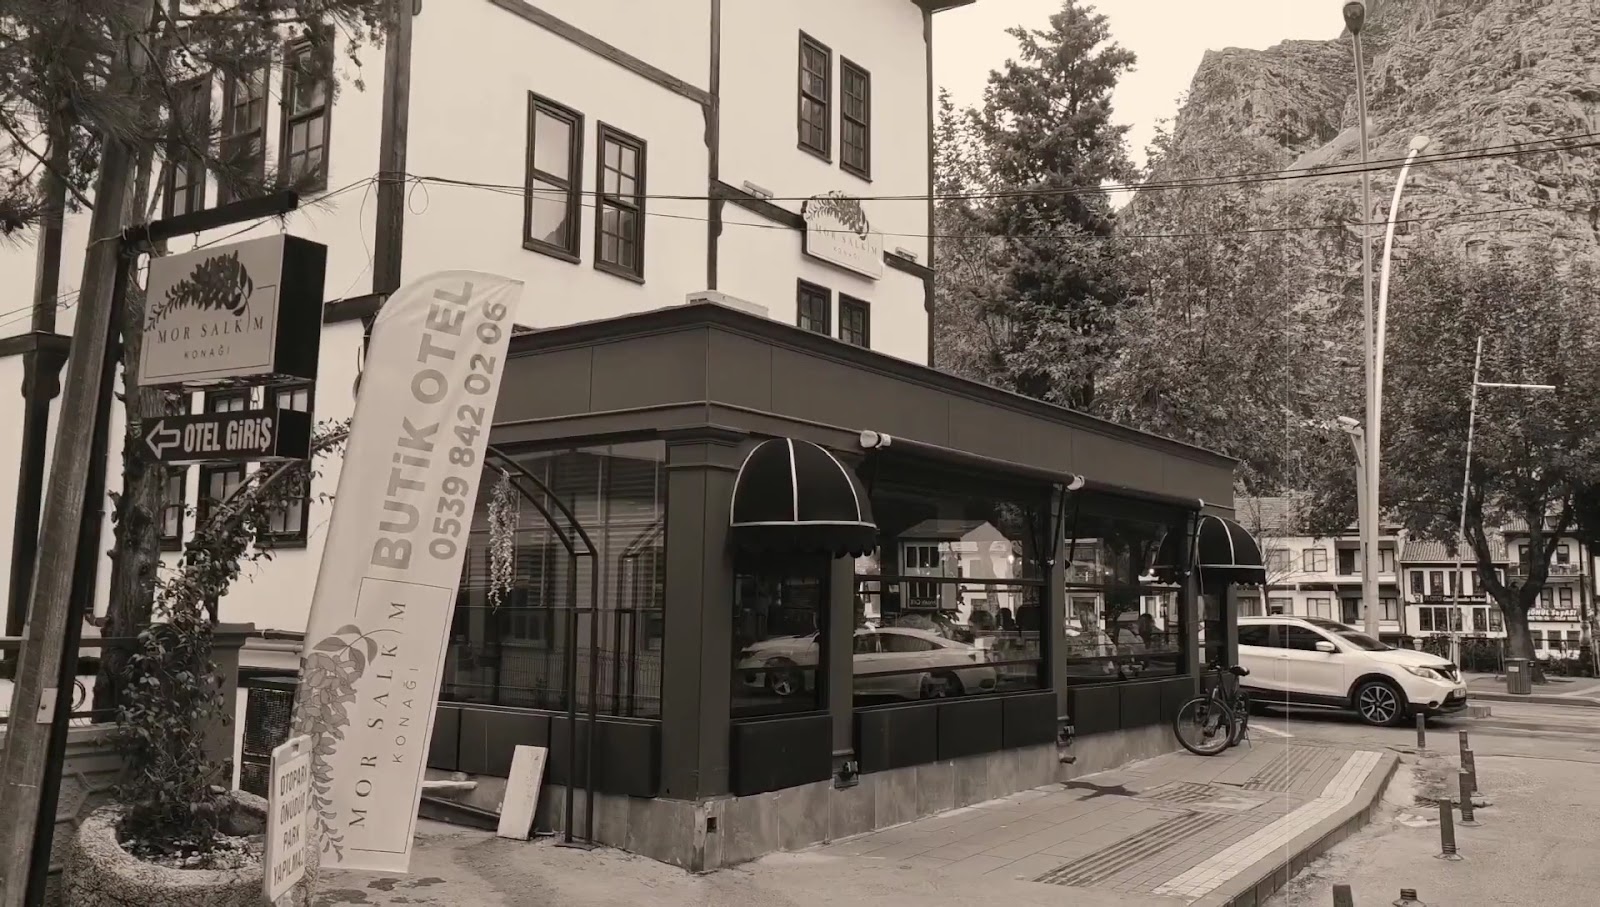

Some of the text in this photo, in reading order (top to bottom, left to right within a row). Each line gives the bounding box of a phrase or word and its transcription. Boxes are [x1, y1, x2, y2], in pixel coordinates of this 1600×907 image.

[157, 315, 264, 344] MOR SALKIM
[410, 281, 474, 405] OTEL
[183, 345, 231, 359] KONAĞI
[183, 422, 221, 453] OTEL
[428, 301, 508, 560] 0539 842 02 06
[348, 601, 407, 828] MOR SALKIM
[392, 667, 419, 764] KONAĞI
[280, 762, 308, 797] OTOPARK
[283, 823, 301, 853] PARK
